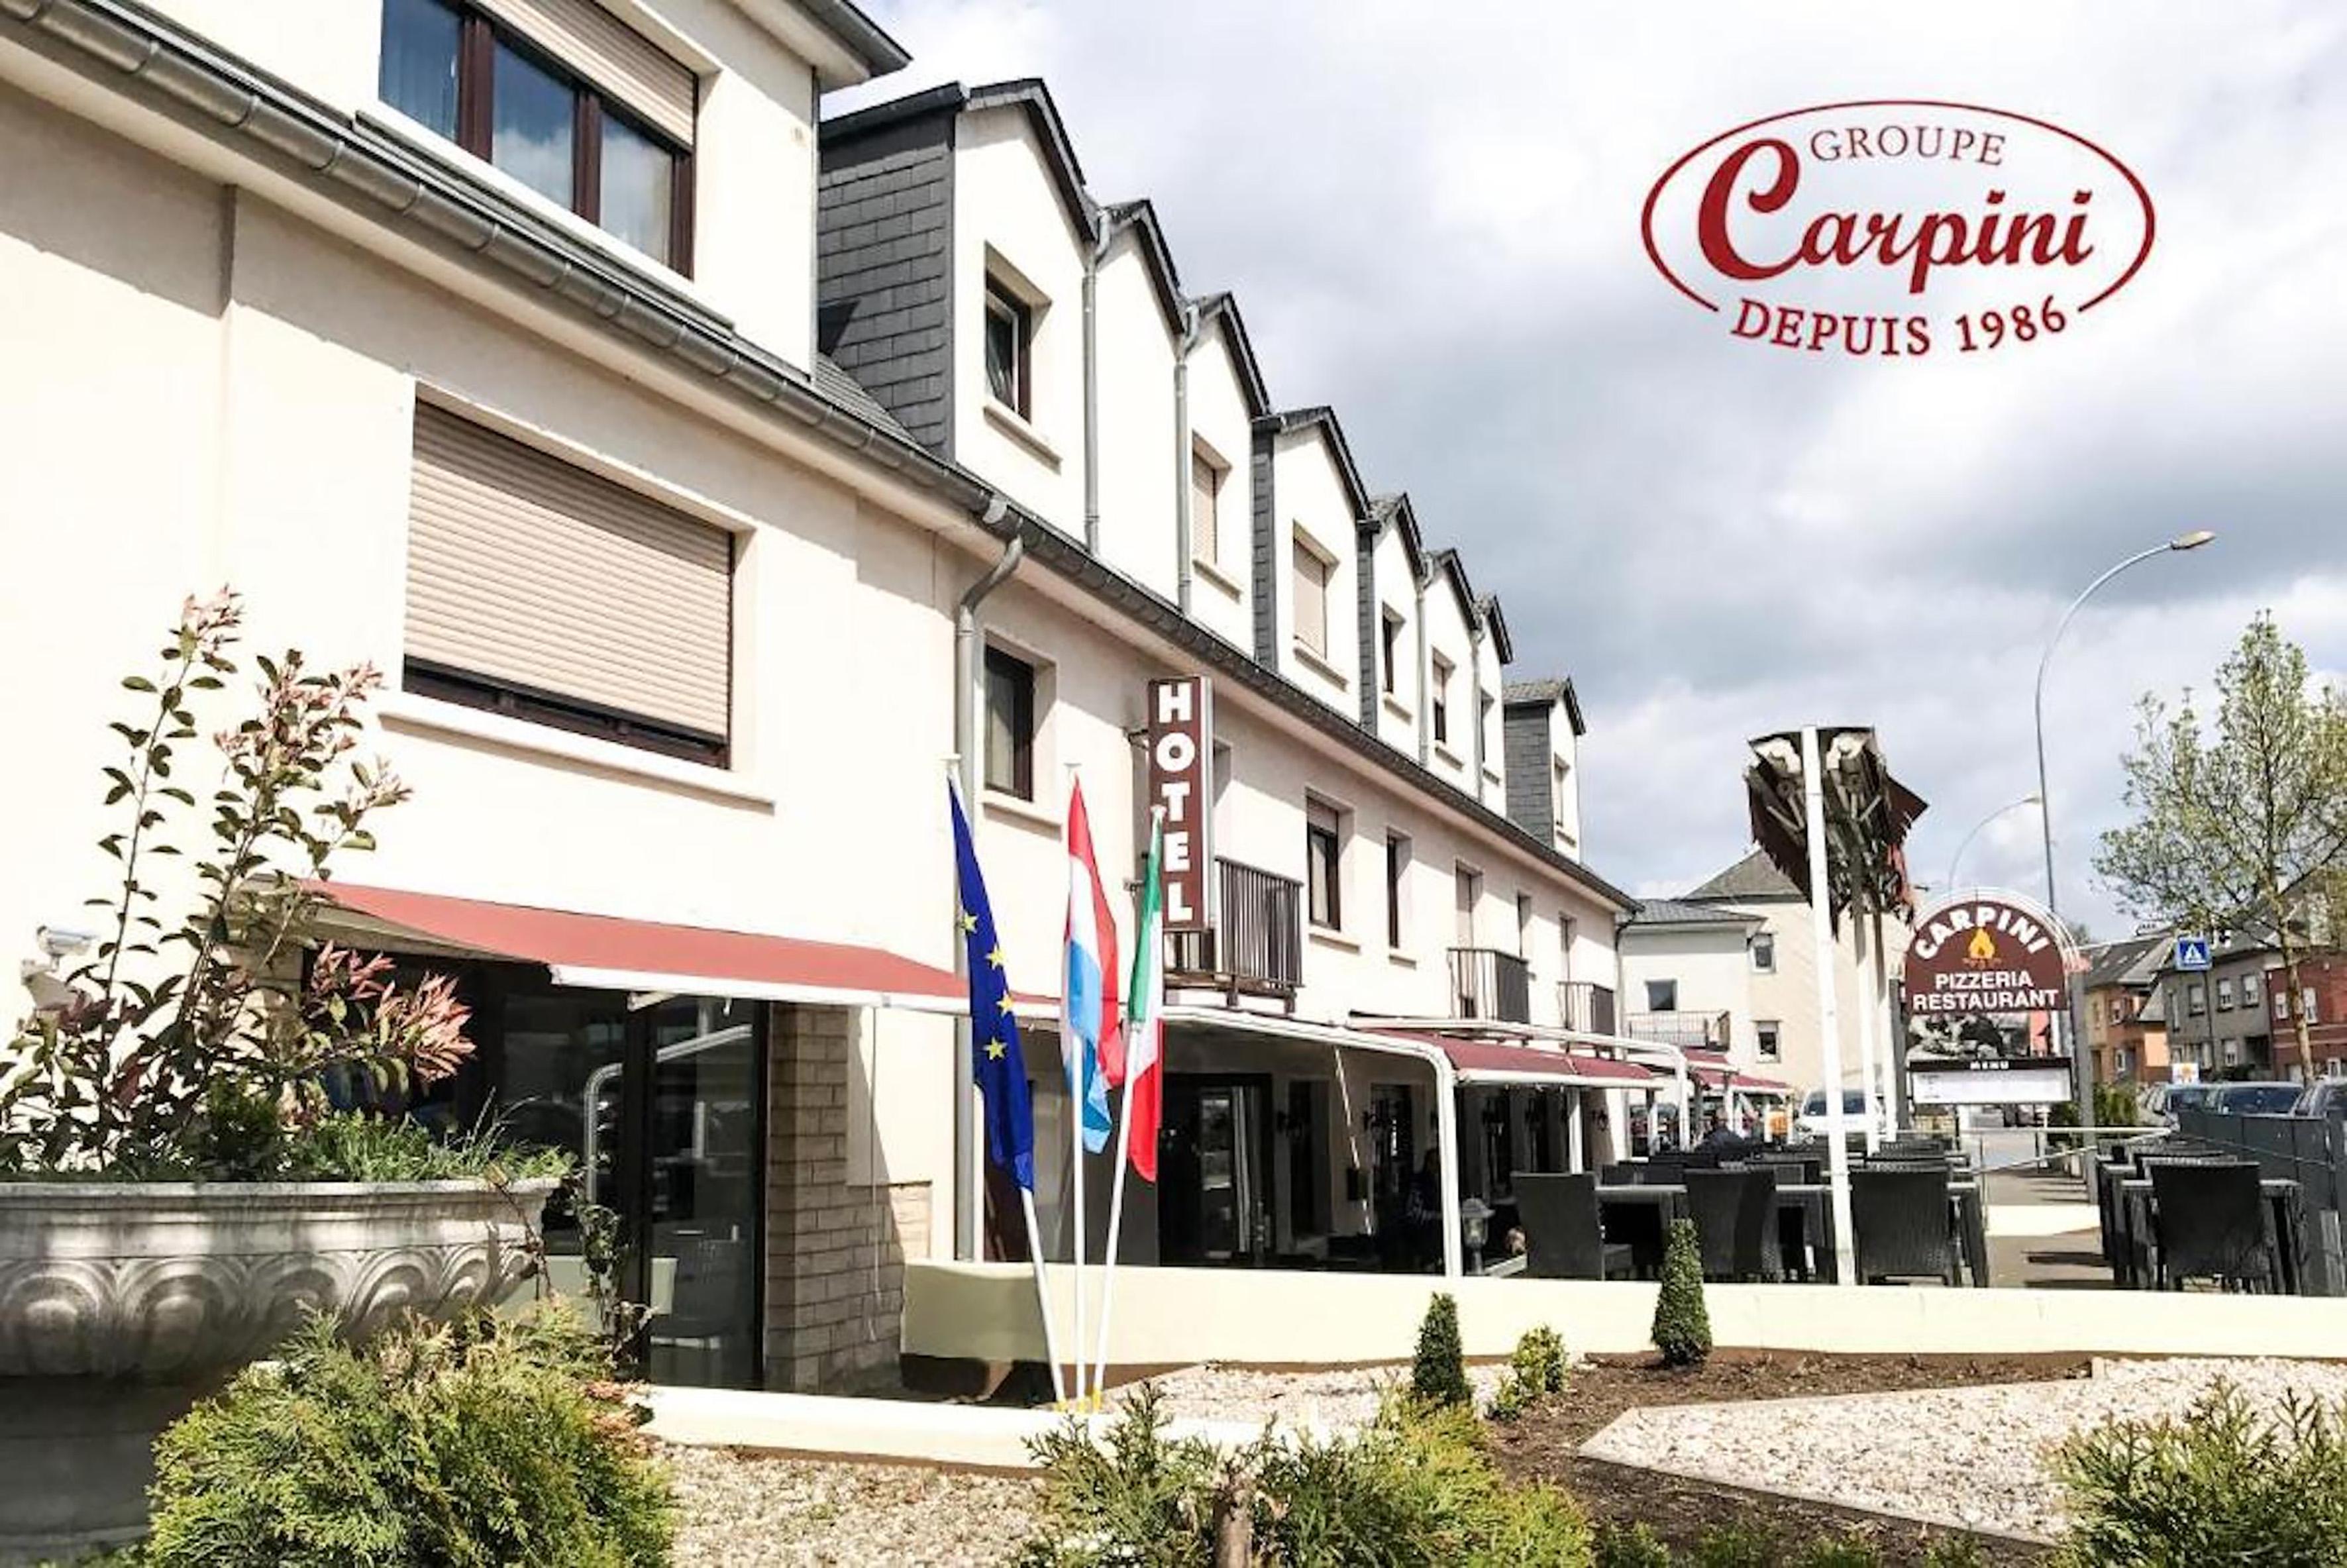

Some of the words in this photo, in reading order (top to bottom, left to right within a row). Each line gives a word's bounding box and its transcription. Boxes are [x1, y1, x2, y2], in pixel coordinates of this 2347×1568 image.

[1155, 681, 1196, 923] HOTEL
[1913, 906, 2051, 960] CARPINI
[1935, 970, 2035, 990] PIZZERIA
[1912, 989, 2060, 1011] RESTAURANT
